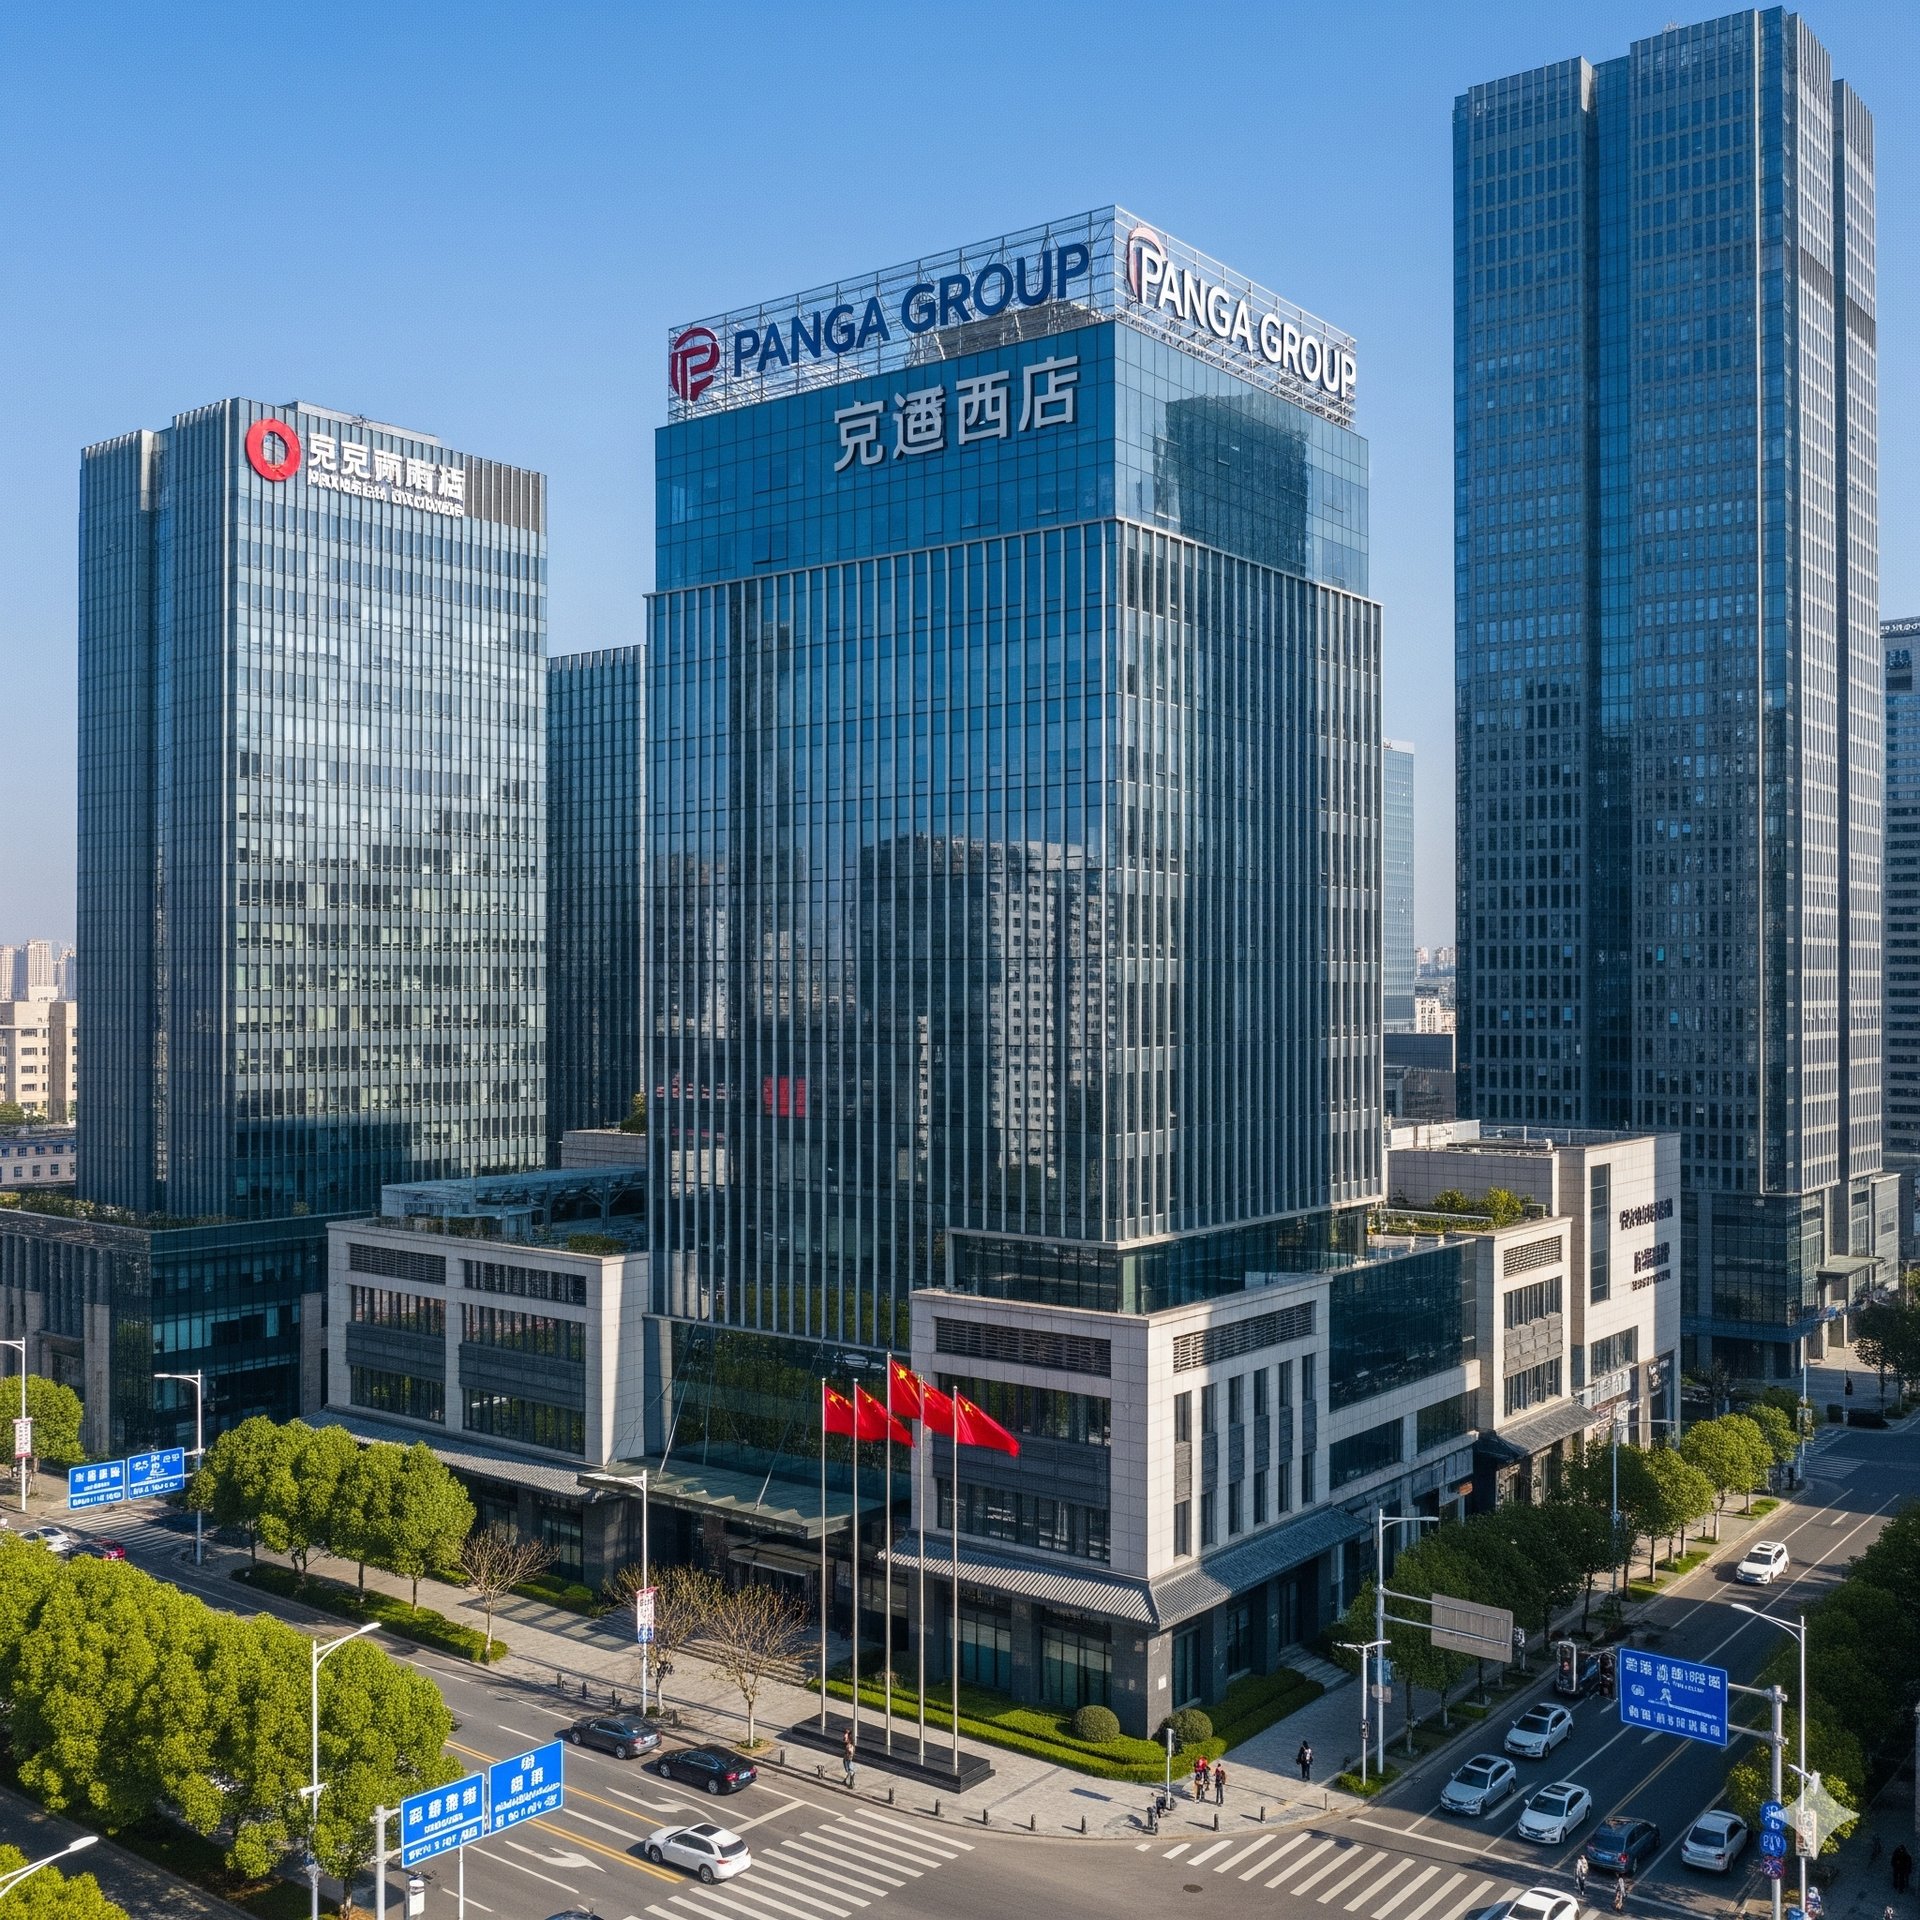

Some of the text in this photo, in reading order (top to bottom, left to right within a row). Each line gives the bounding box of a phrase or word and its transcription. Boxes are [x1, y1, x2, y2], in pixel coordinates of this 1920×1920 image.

[733, 243, 1090, 377] PANGA GROUP
[1140, 246, 1356, 398] PANGA GROUP
